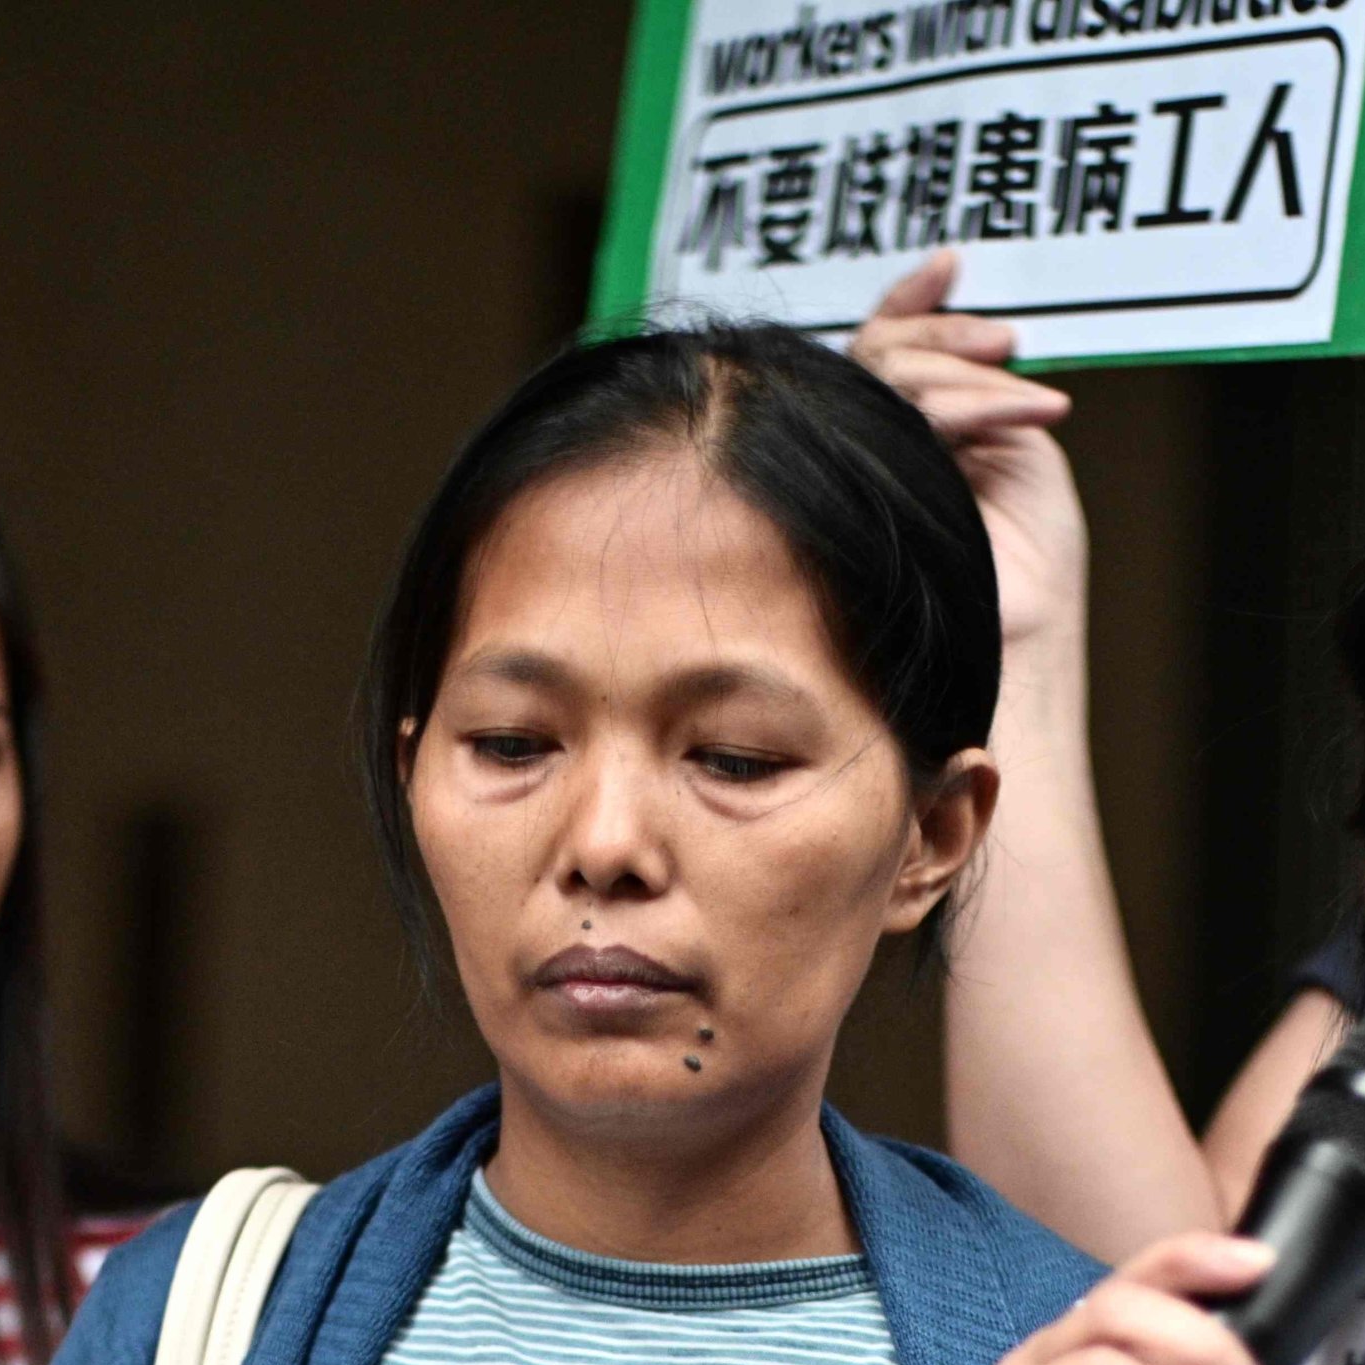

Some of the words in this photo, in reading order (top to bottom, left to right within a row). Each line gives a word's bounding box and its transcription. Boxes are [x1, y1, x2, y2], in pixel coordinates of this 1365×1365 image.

[701, 6, 897, 95] workers
[679, 82, 1305, 272] 不要歧視患病工人
